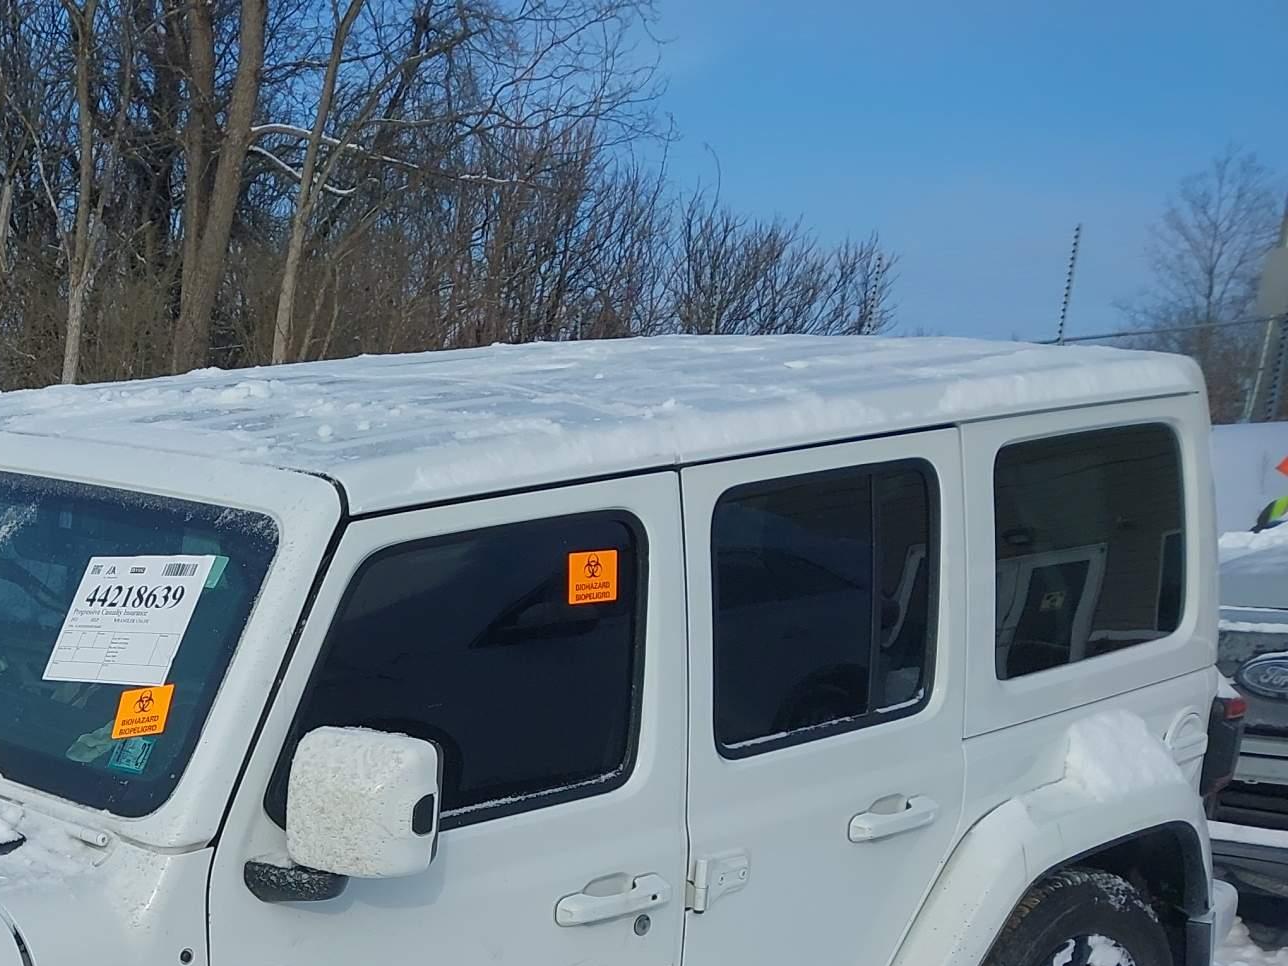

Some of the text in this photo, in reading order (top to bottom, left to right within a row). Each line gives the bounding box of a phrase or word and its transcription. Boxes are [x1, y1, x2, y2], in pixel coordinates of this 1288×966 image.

[575, 581, 610, 591] BIOHAZARD
[85, 584, 185, 609] 44218639
[575, 591, 611, 601] BIOPELIGRO
[121, 715, 160, 727] BIOHAZARD
[118, 724, 158, 737] BIOPELIGRO
